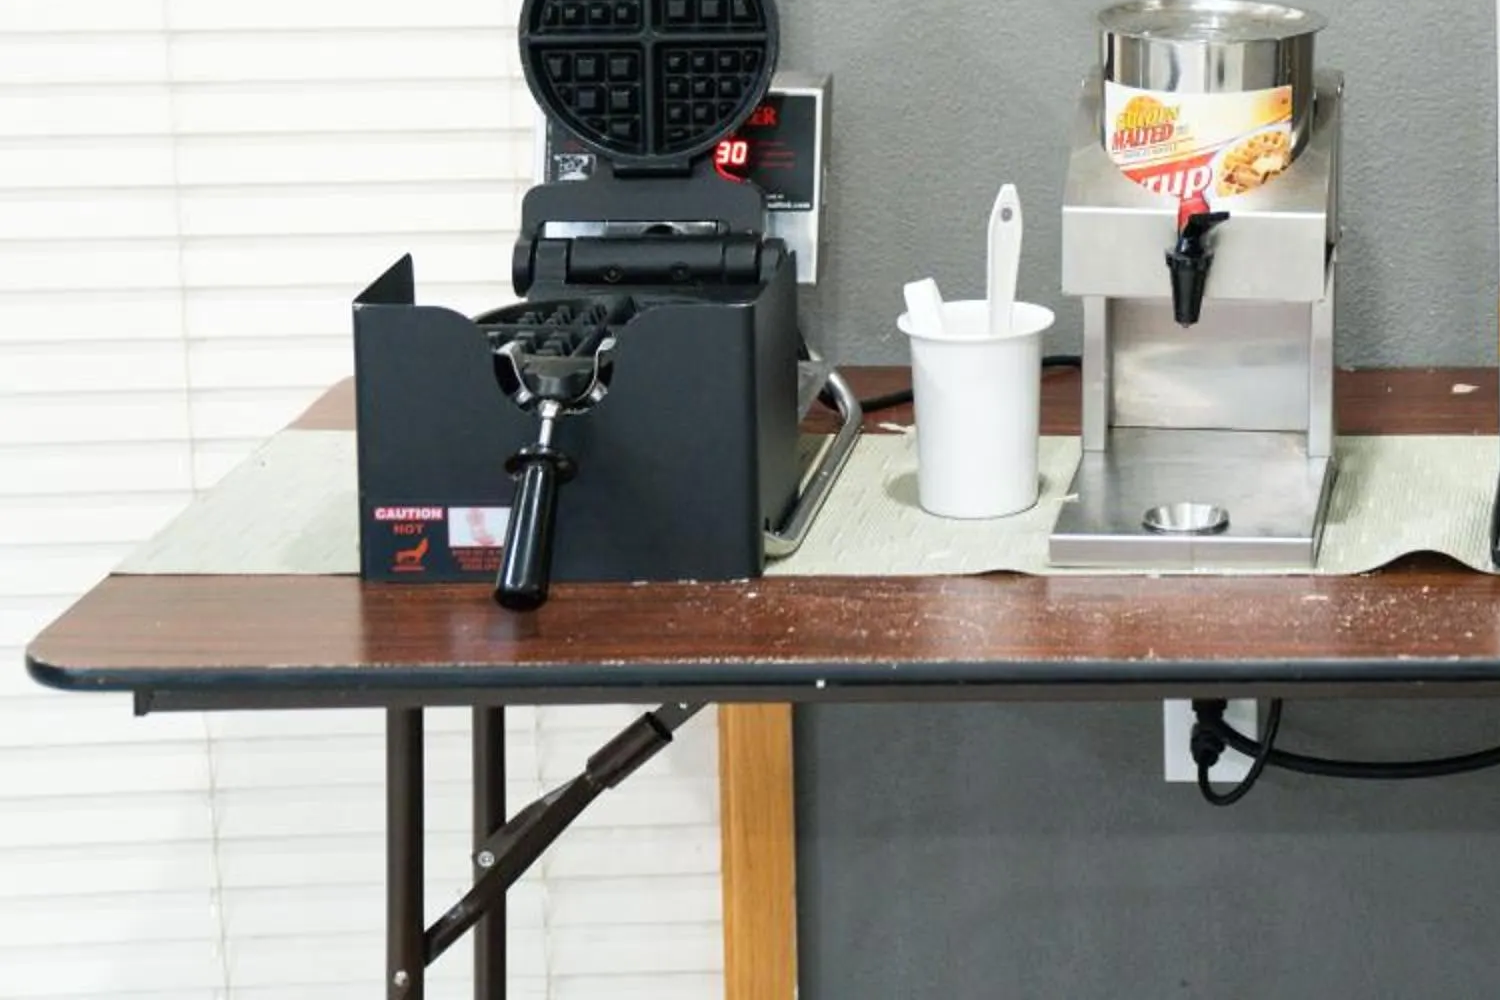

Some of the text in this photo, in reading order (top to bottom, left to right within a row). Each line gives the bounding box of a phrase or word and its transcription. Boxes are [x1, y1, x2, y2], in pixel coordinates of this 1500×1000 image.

[1111, 121, 1175, 151] MALTED
[716, 141, 747, 165] 30
[1143, 166, 1212, 200] rup
[374, 507, 443, 520] CAUTION
[392, 524, 425, 535] HOT
